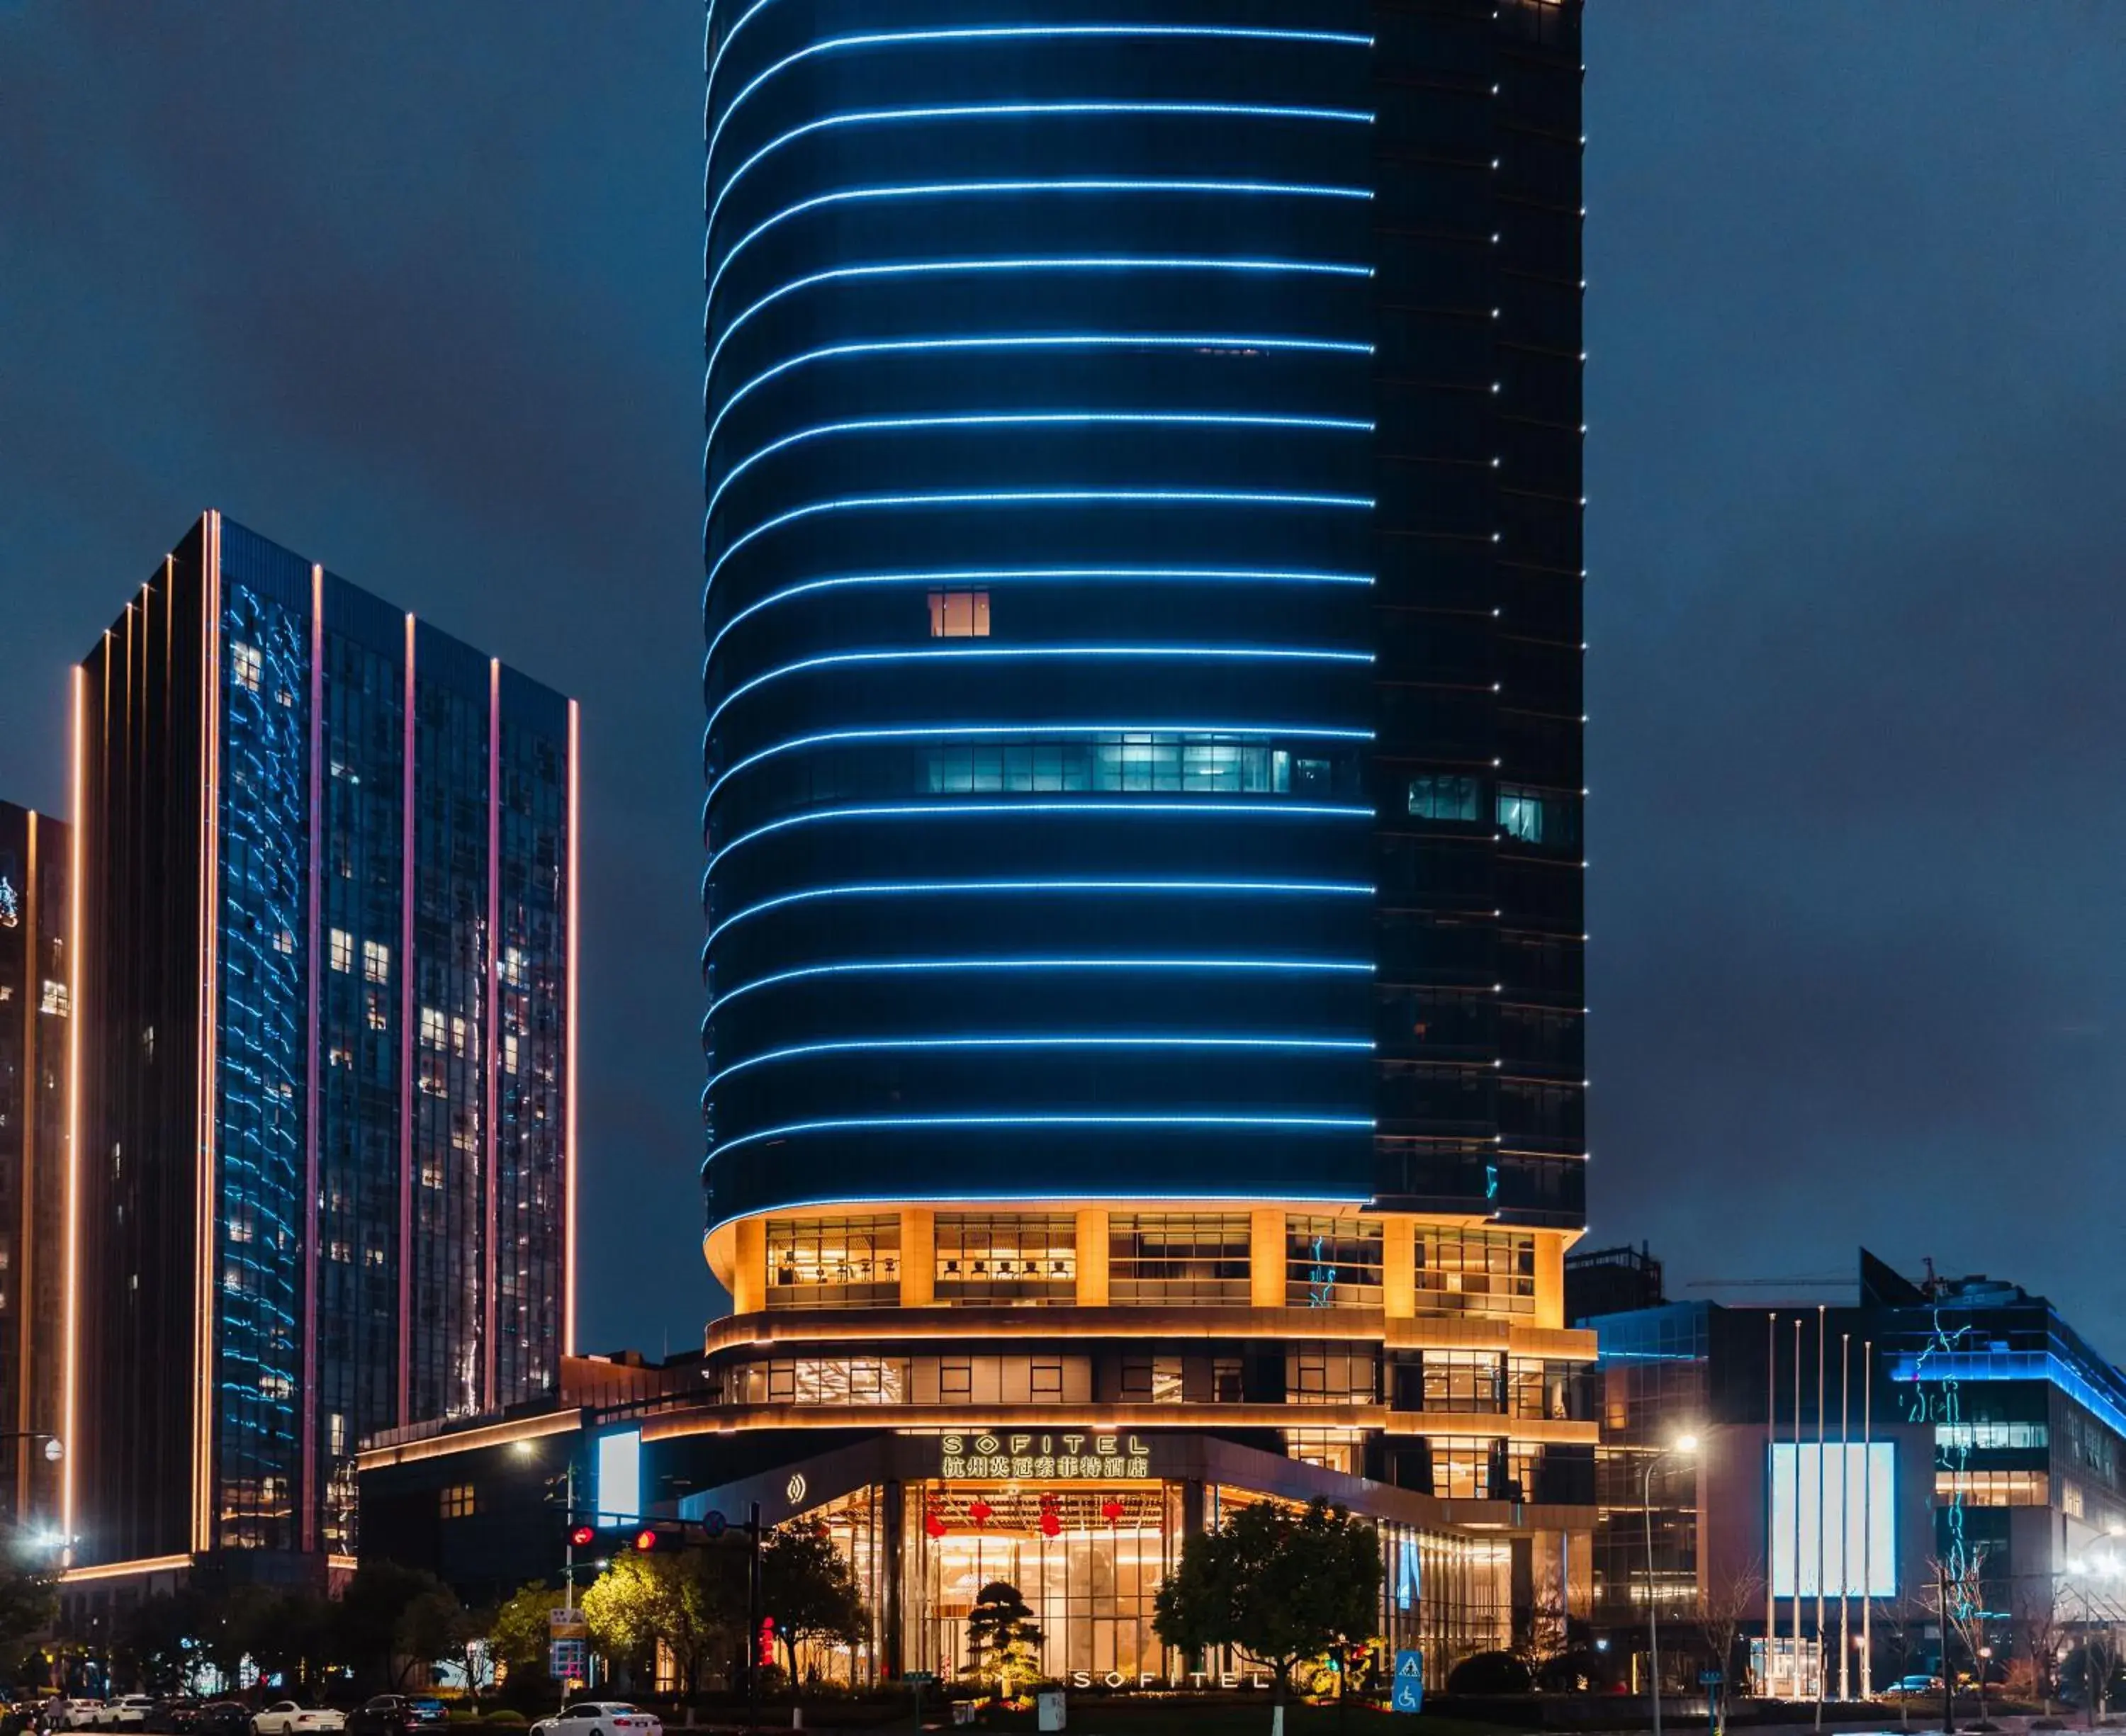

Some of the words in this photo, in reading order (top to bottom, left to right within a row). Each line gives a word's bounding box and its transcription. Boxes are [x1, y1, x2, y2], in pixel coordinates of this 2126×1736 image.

[943, 1435, 1149, 1453] SOFITEL
[943, 1456, 1149, 1478] 杭州英冠索菲特酒店
[1074, 1672, 1269, 1689] SOFITEL
